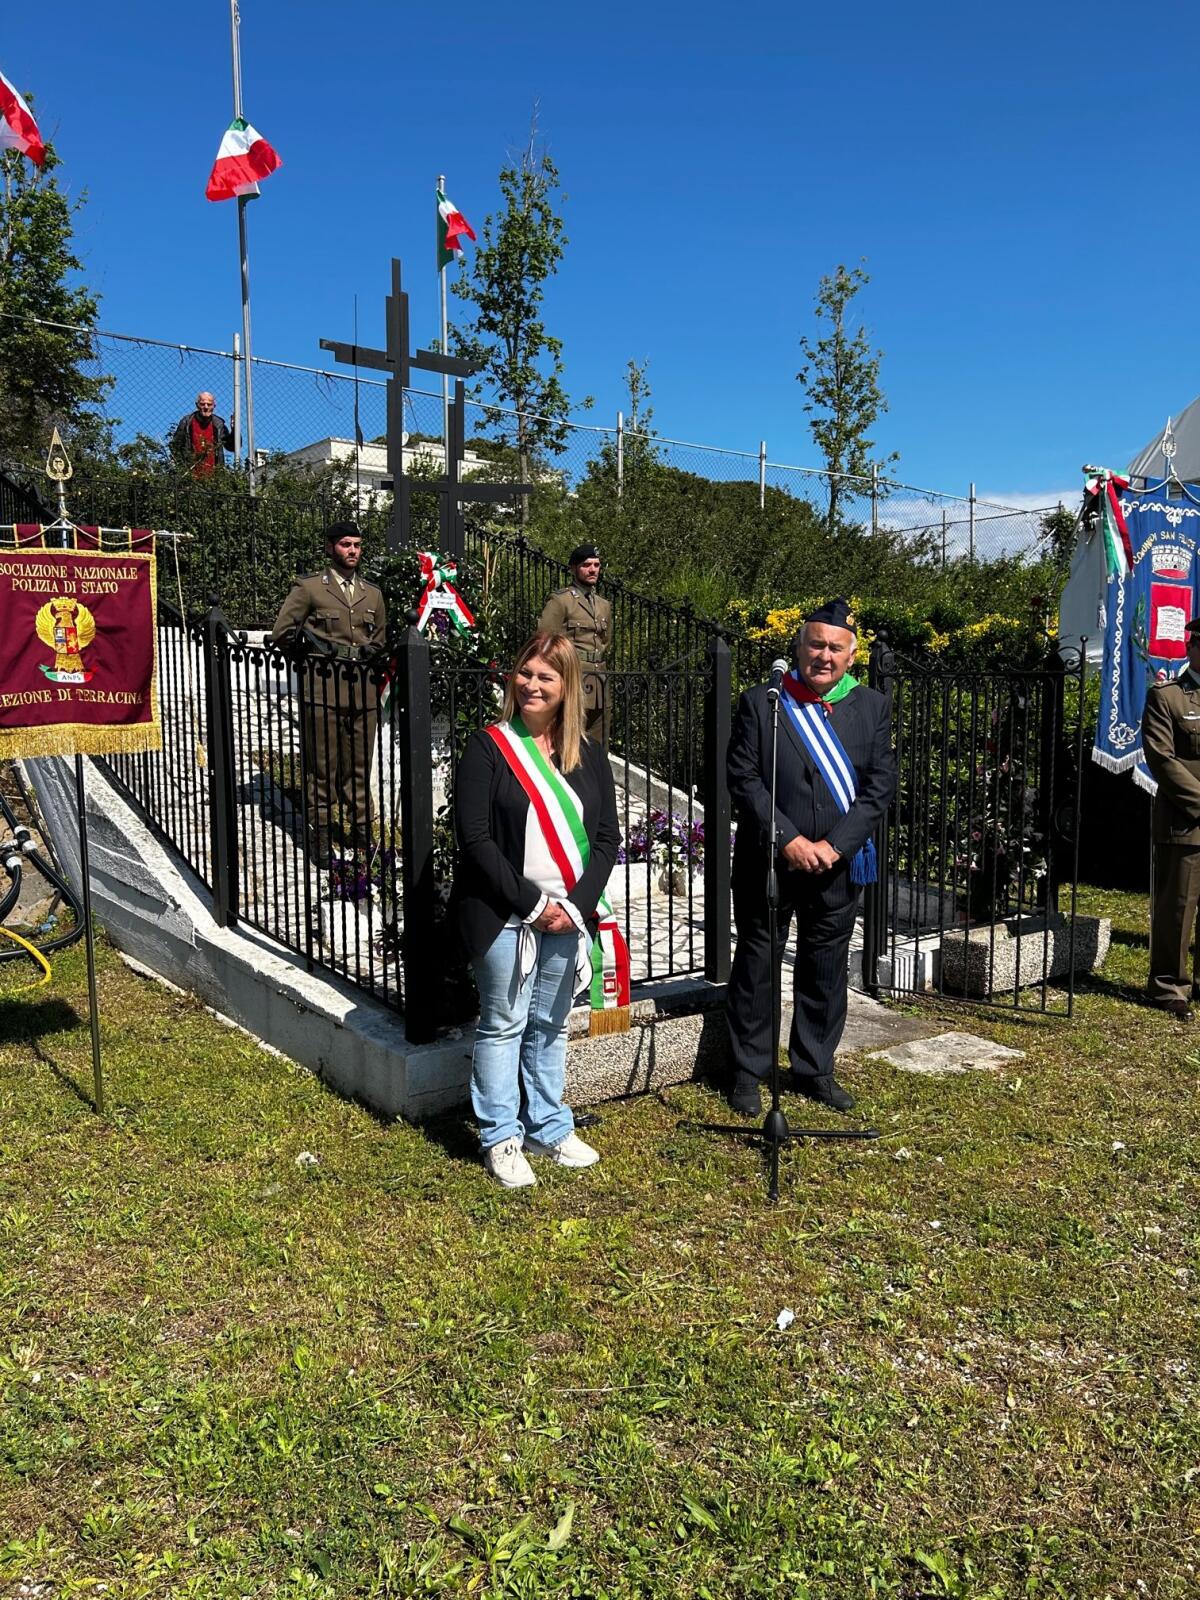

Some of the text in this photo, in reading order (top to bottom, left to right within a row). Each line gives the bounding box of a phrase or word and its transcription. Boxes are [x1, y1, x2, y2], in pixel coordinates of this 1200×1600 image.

[1160, 530, 1176, 540] SAN
[74, 566, 138, 580] NAZIONALE
[12, 578, 119, 594] POLIZIA DI STATO
[57, 688, 73, 701] DI
[76, 689, 143, 705] TERRACINA
